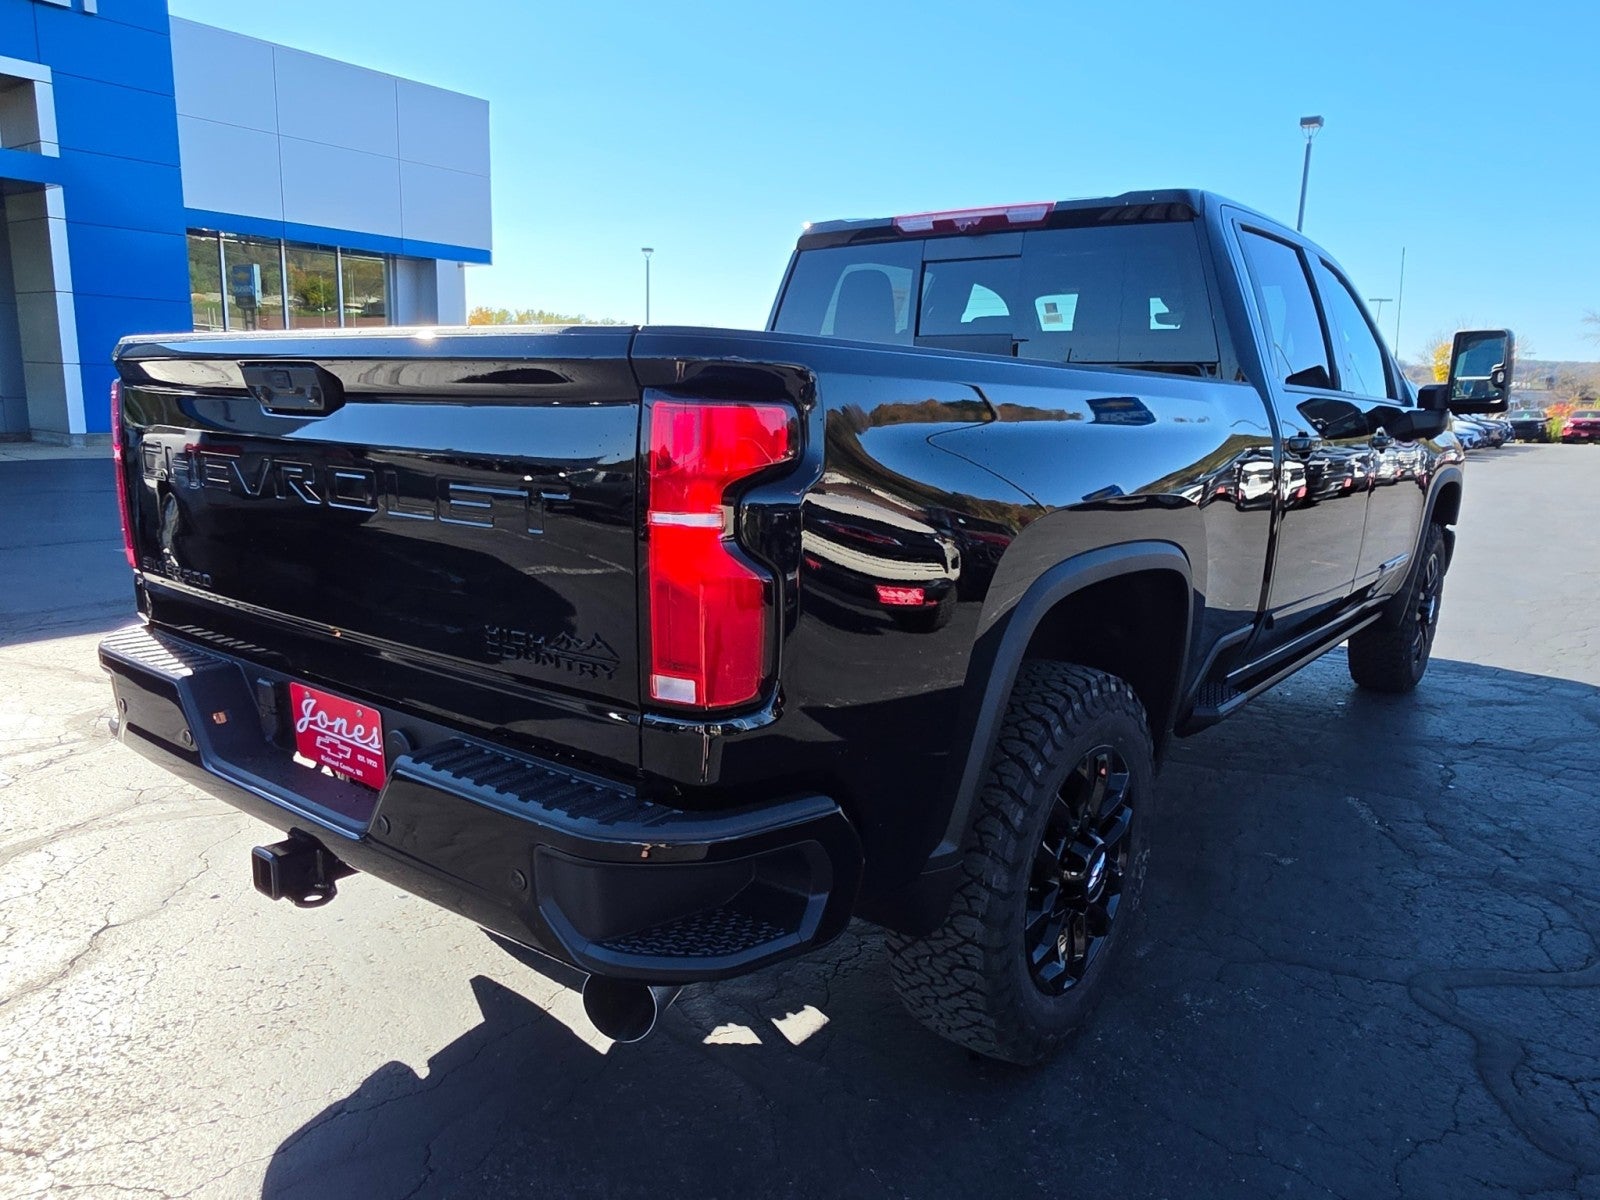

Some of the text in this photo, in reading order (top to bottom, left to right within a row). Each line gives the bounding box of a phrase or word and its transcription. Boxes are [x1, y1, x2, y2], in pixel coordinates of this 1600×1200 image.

[140, 441, 570, 535] CHEVROLET
[486, 641, 619, 680] COUNTRY
[297, 699, 381, 749] Jones
